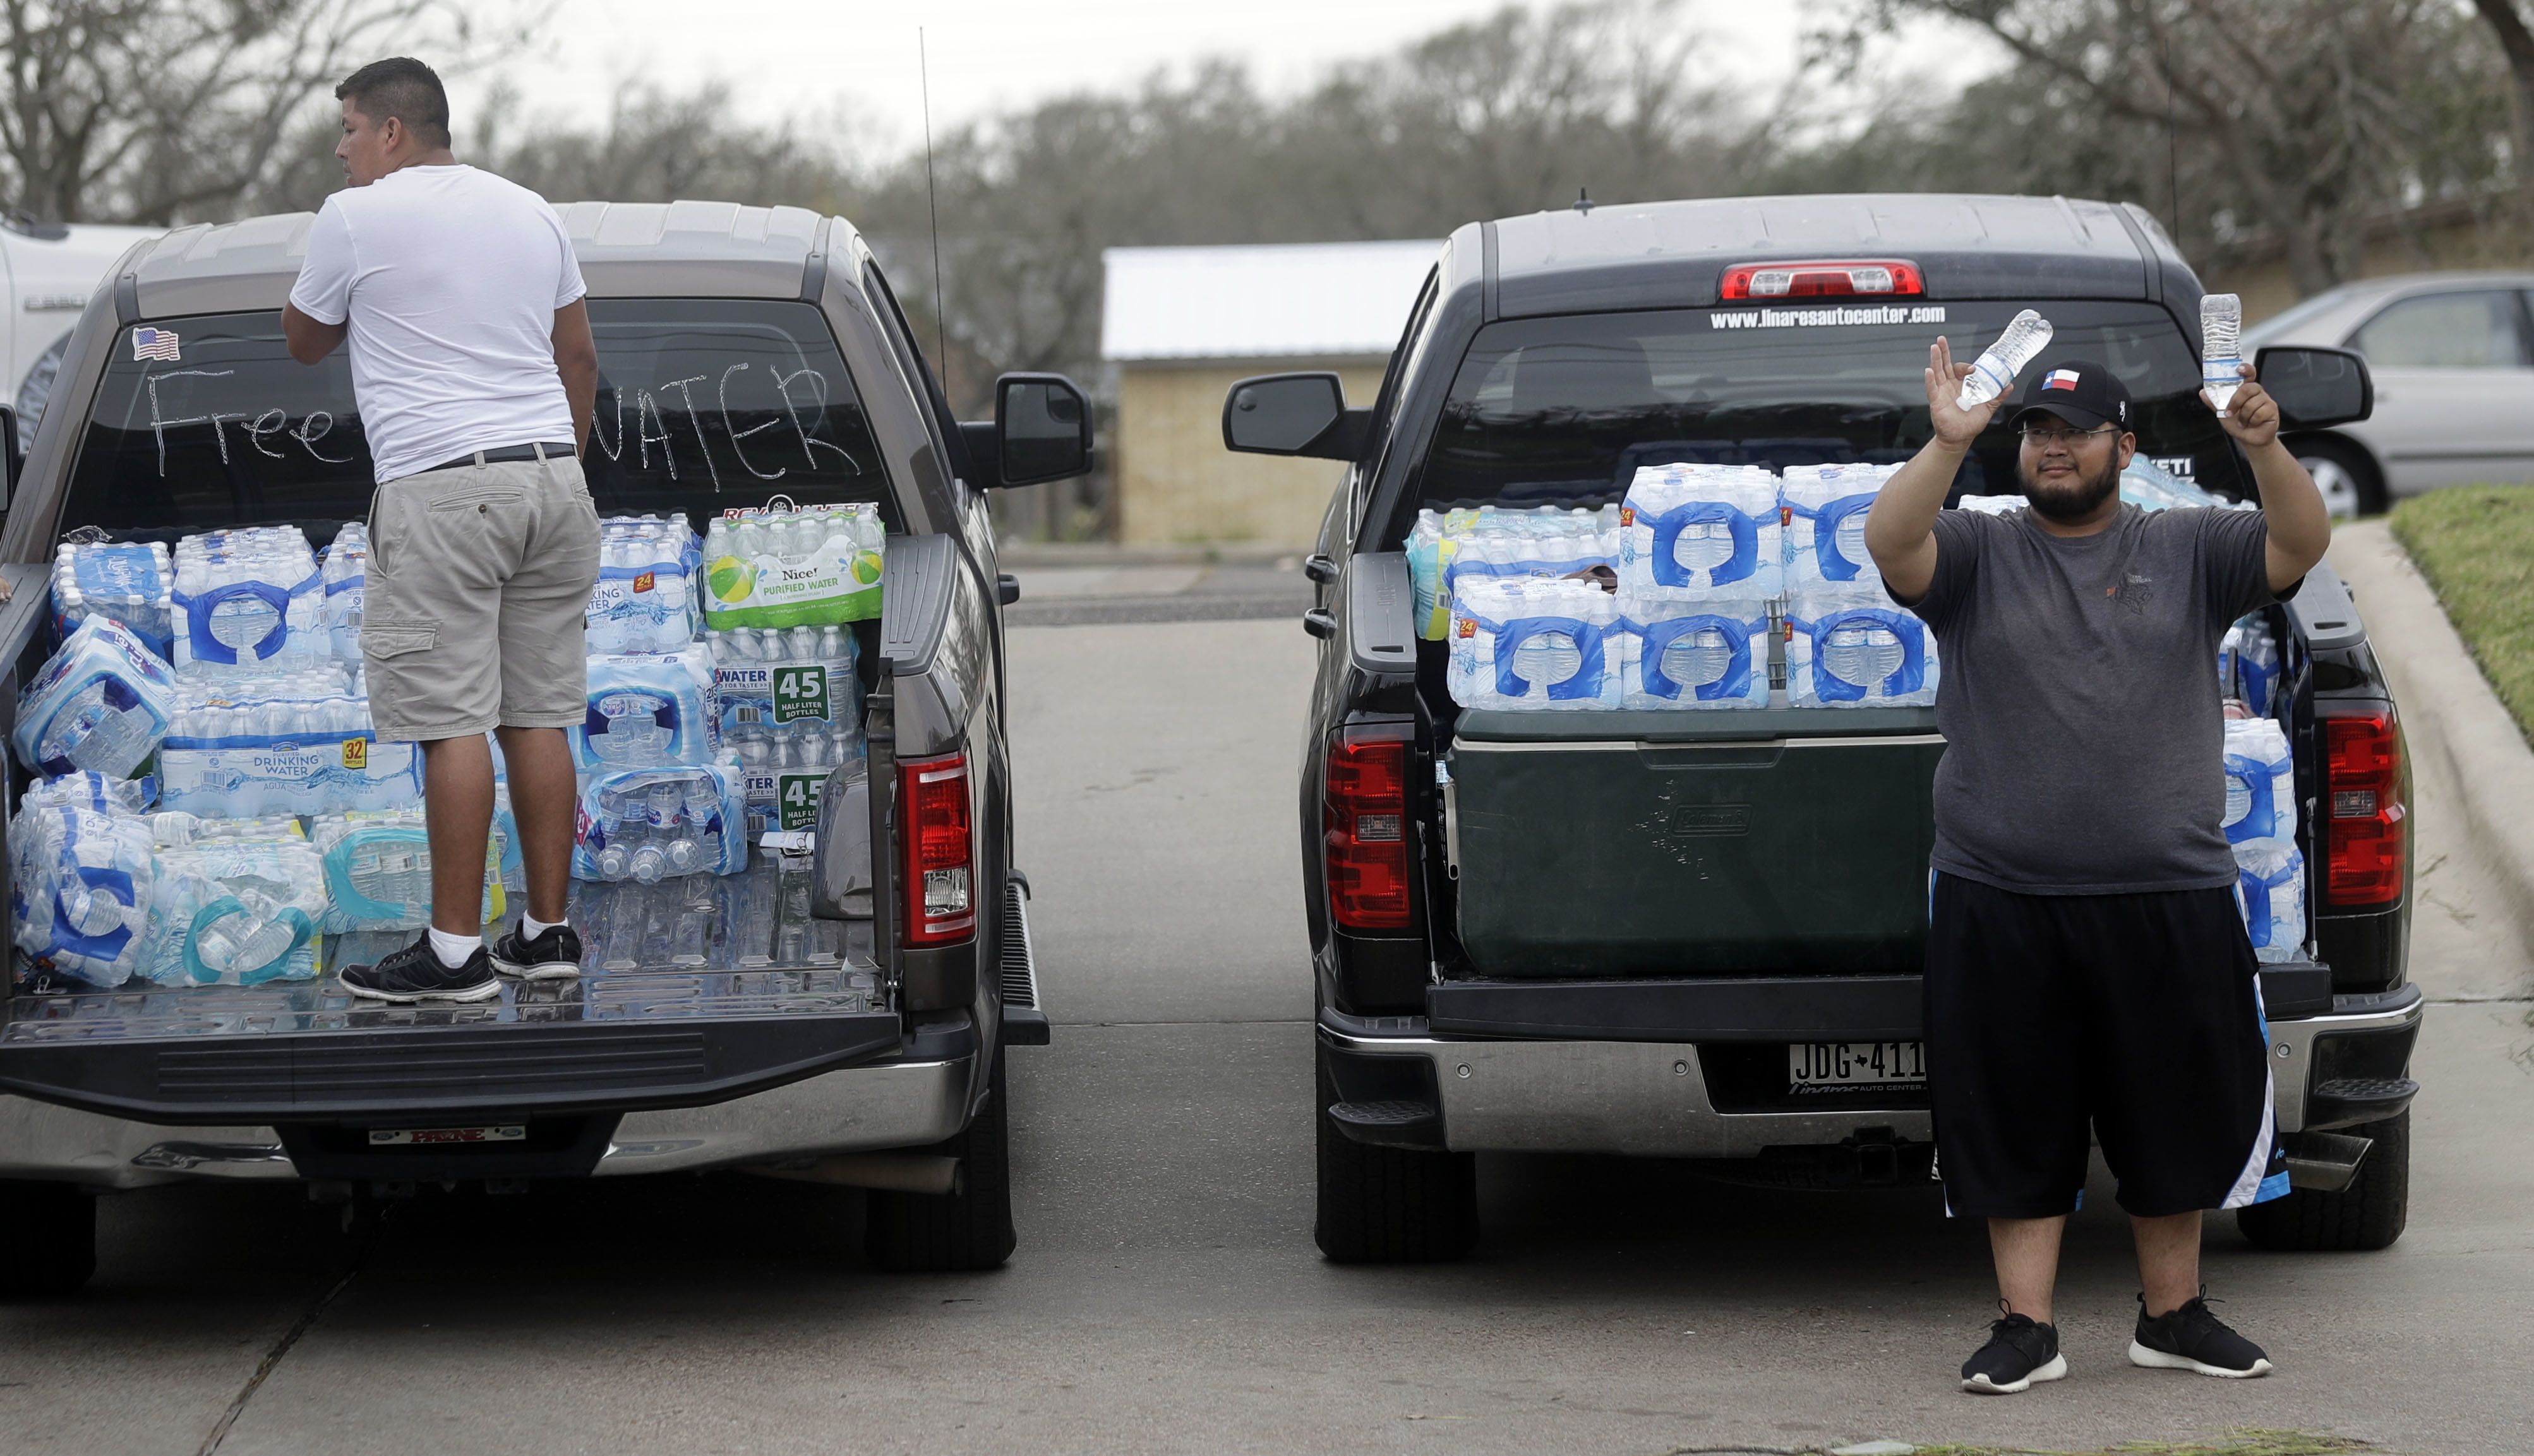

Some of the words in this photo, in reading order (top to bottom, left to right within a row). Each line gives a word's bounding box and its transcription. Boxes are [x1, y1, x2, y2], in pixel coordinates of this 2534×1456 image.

[1710, 306, 1945, 329] www.linaresautocenter.com
[148, 369, 353, 477] Free
[2151, 458, 2192, 474] ETI
[637, 574, 651, 586] 24
[782, 567, 819, 581] Nice!
[763, 582, 805, 596] PURIFIED
[808, 578, 839, 590] WATER
[585, 600, 610, 610] ATER
[1460, 621, 1474, 631] 24
[719, 670, 767, 682] WATER
[779, 672, 820, 699] 45
[782, 703, 800, 711] HALF
[802, 701, 822, 710] LITER
[786, 709, 819, 718] BOTTLES
[345, 741, 363, 760] 32
[254, 755, 319, 767] DRINKING
[265, 767, 309, 776] WATER
[263, 782, 287, 791] AGUA
[747, 778, 774, 789] TER
[785, 780, 825, 807] 45
[788, 811, 806, 819] HALF
[792, 816, 815, 826] BOTTL
[1796, 1044, 1851, 1079] JDG
[1870, 1042, 1926, 1078] 411
[411, 1128, 486, 1143] PAYNE
